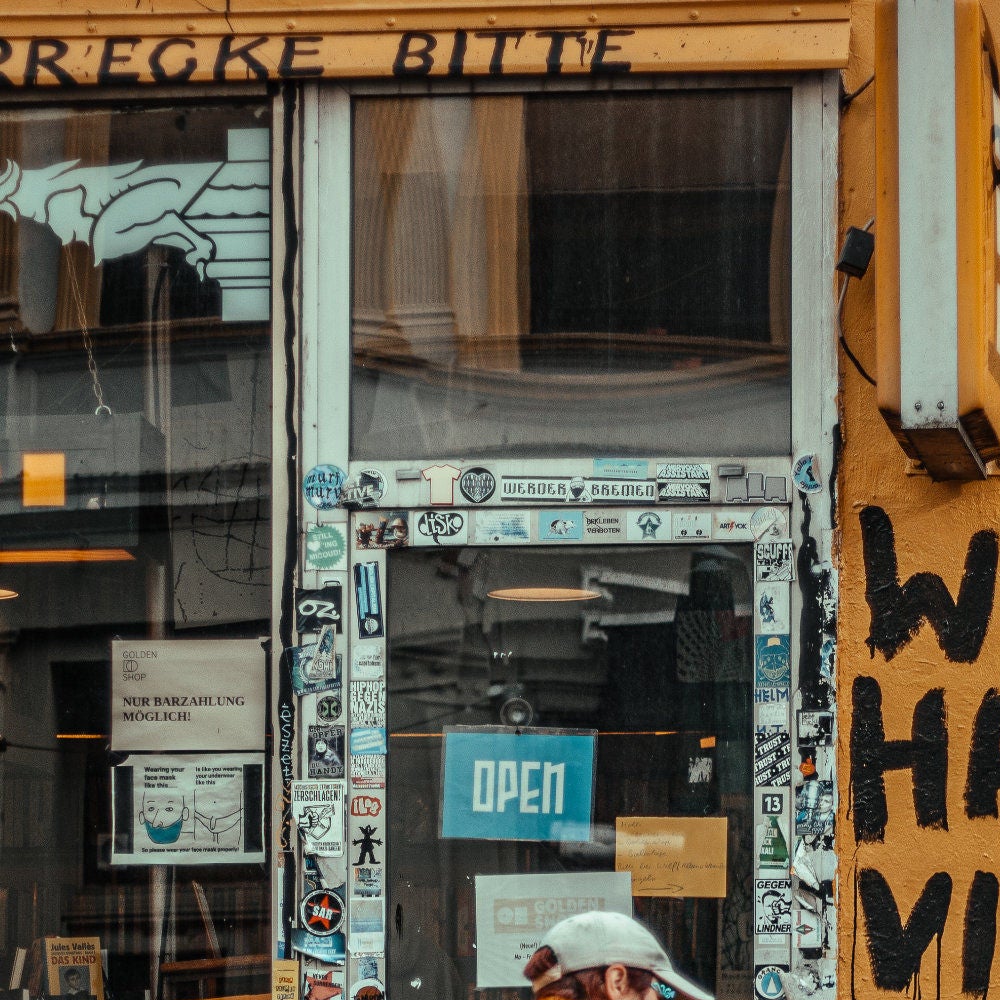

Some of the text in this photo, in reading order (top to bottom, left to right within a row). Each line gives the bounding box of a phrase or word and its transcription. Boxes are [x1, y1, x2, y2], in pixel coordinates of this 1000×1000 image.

[392, 29, 635, 76] BITTE
[658, 469, 709, 479] ASSISTANT
[503, 482, 566, 495] WERDER
[591, 482, 654, 495] BREMEN
[658, 490, 709, 498] ASSISTANT
[122, 651, 158, 659] GOLDEN
[122, 673, 146, 681] SHOP
[350, 681, 385, 691] HIPHOP
[350, 691, 385, 701] GEGEN
[755, 688, 790, 702] HELM
[122, 696, 245, 707] NUR BARZAHLUNG
[350, 701, 385, 713] NAZIS
[122, 710, 191, 722] MÖGLICH!
[758, 734, 782, 755] TRUST
[472, 760, 565, 814] OPEN
[764, 796, 780, 812] 13
[757, 880, 792, 889] GEGEN
[757, 924, 792, 933] LINDNER
[51, 943, 70, 951] Jules
[52, 956, 96, 965] DAS KIND
